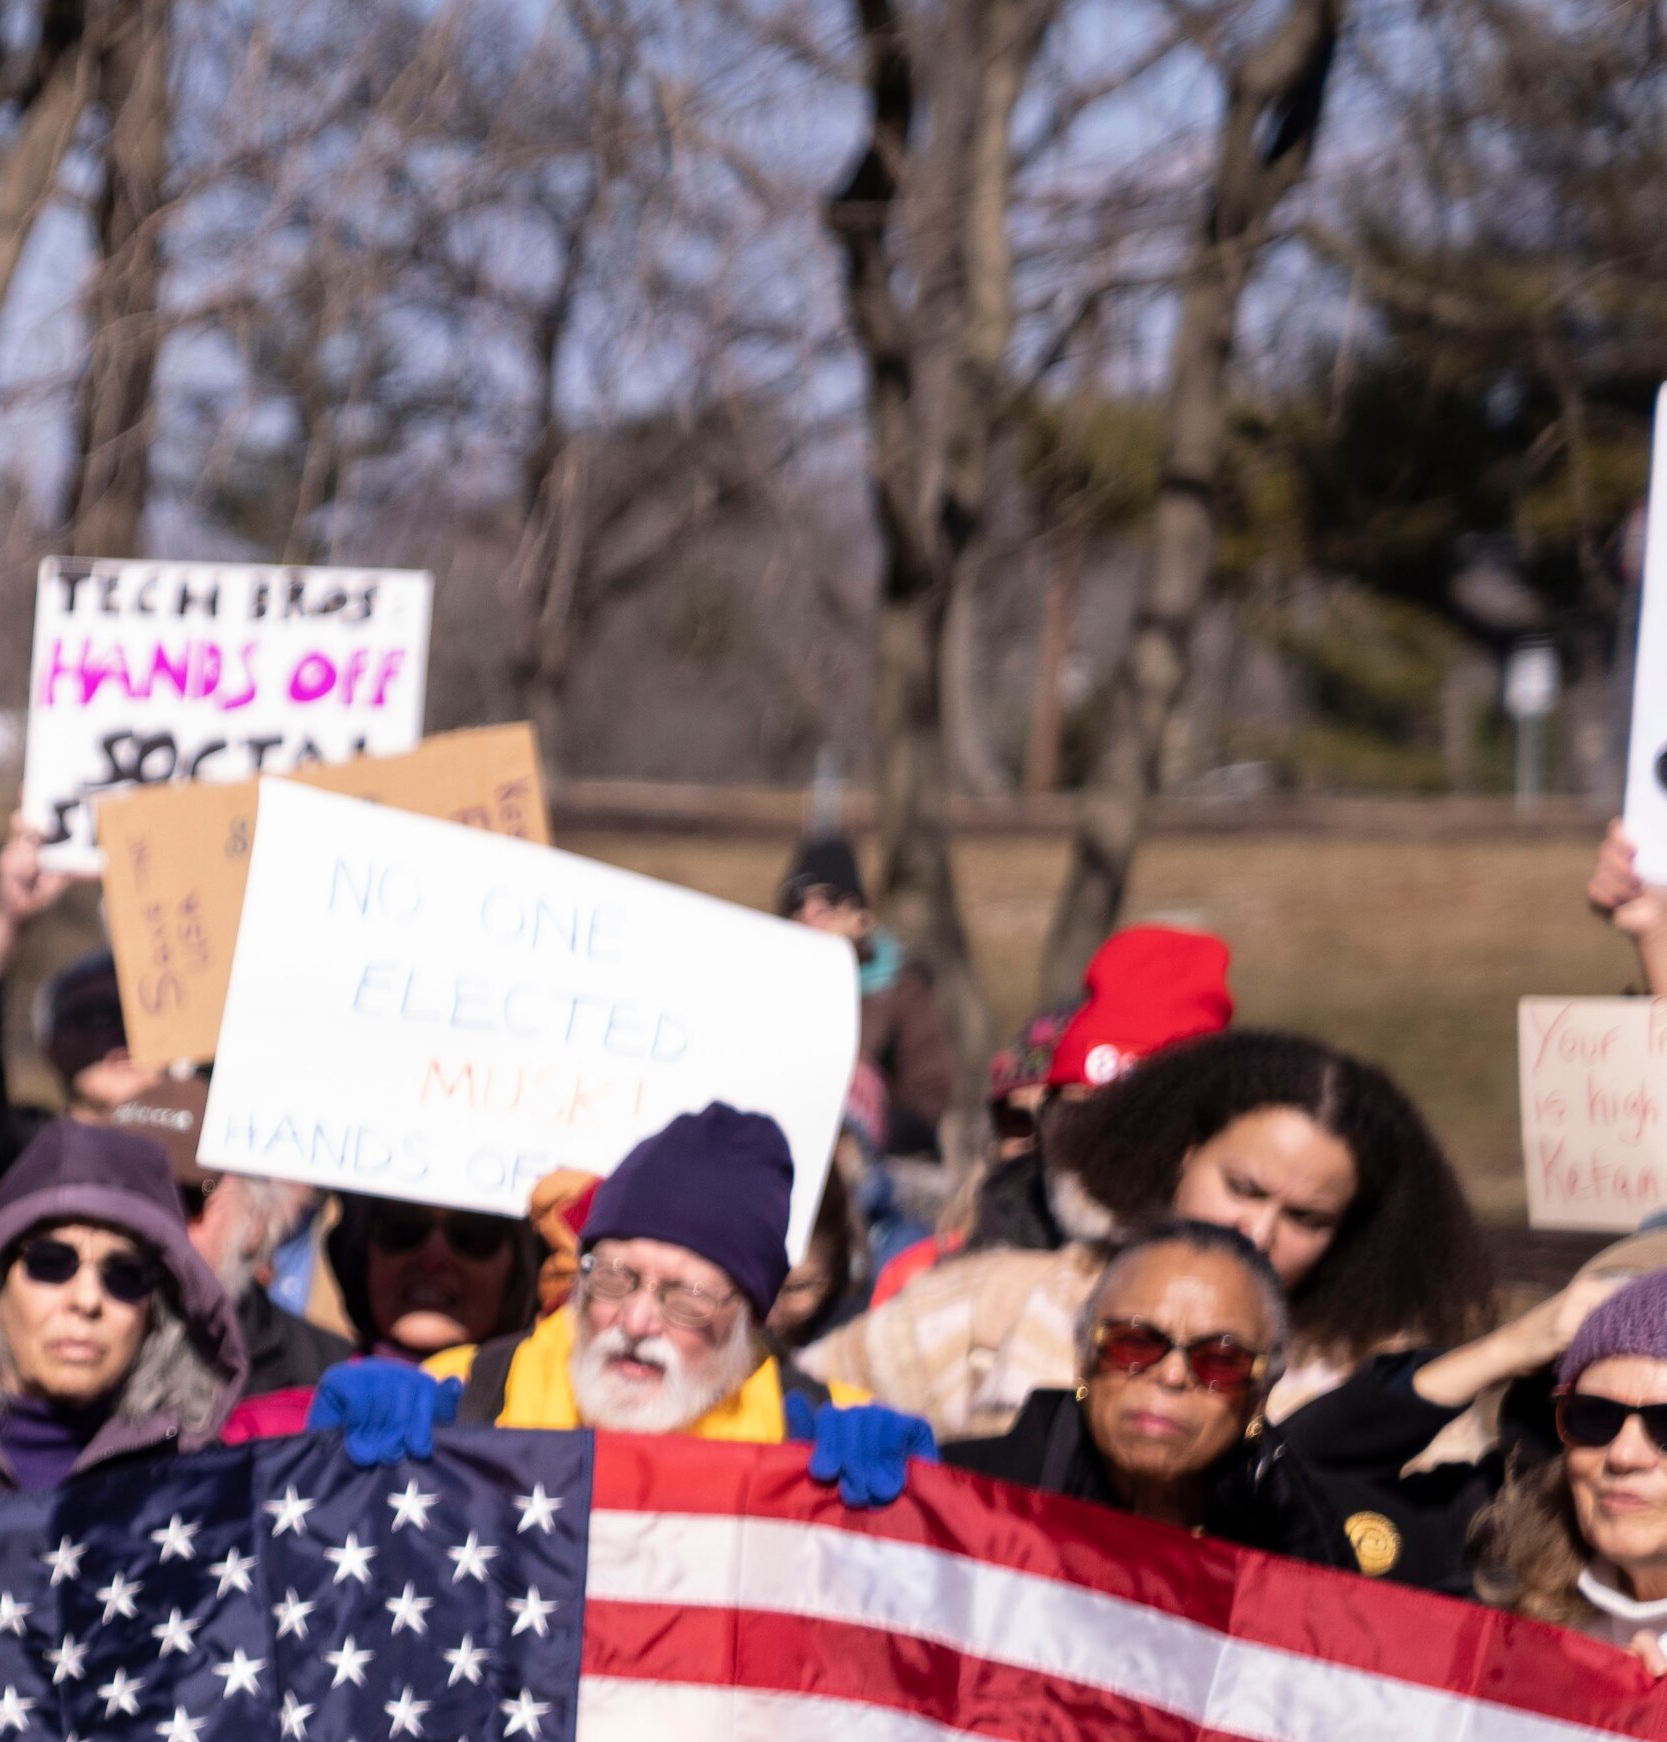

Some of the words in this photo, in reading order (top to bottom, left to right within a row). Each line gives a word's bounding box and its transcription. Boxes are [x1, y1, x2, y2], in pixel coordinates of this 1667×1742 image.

[55, 567, 220, 620] TECH
[41, 637, 260, 711] HANDS
[286, 646, 406, 709] OFF
[328, 856, 422, 921] NO
[480, 886, 625, 961] ONE
[353, 960, 691, 1064] ELECTED
[1529, 1001, 1621, 1076] Your
[224, 1108, 428, 1183] HANDS
